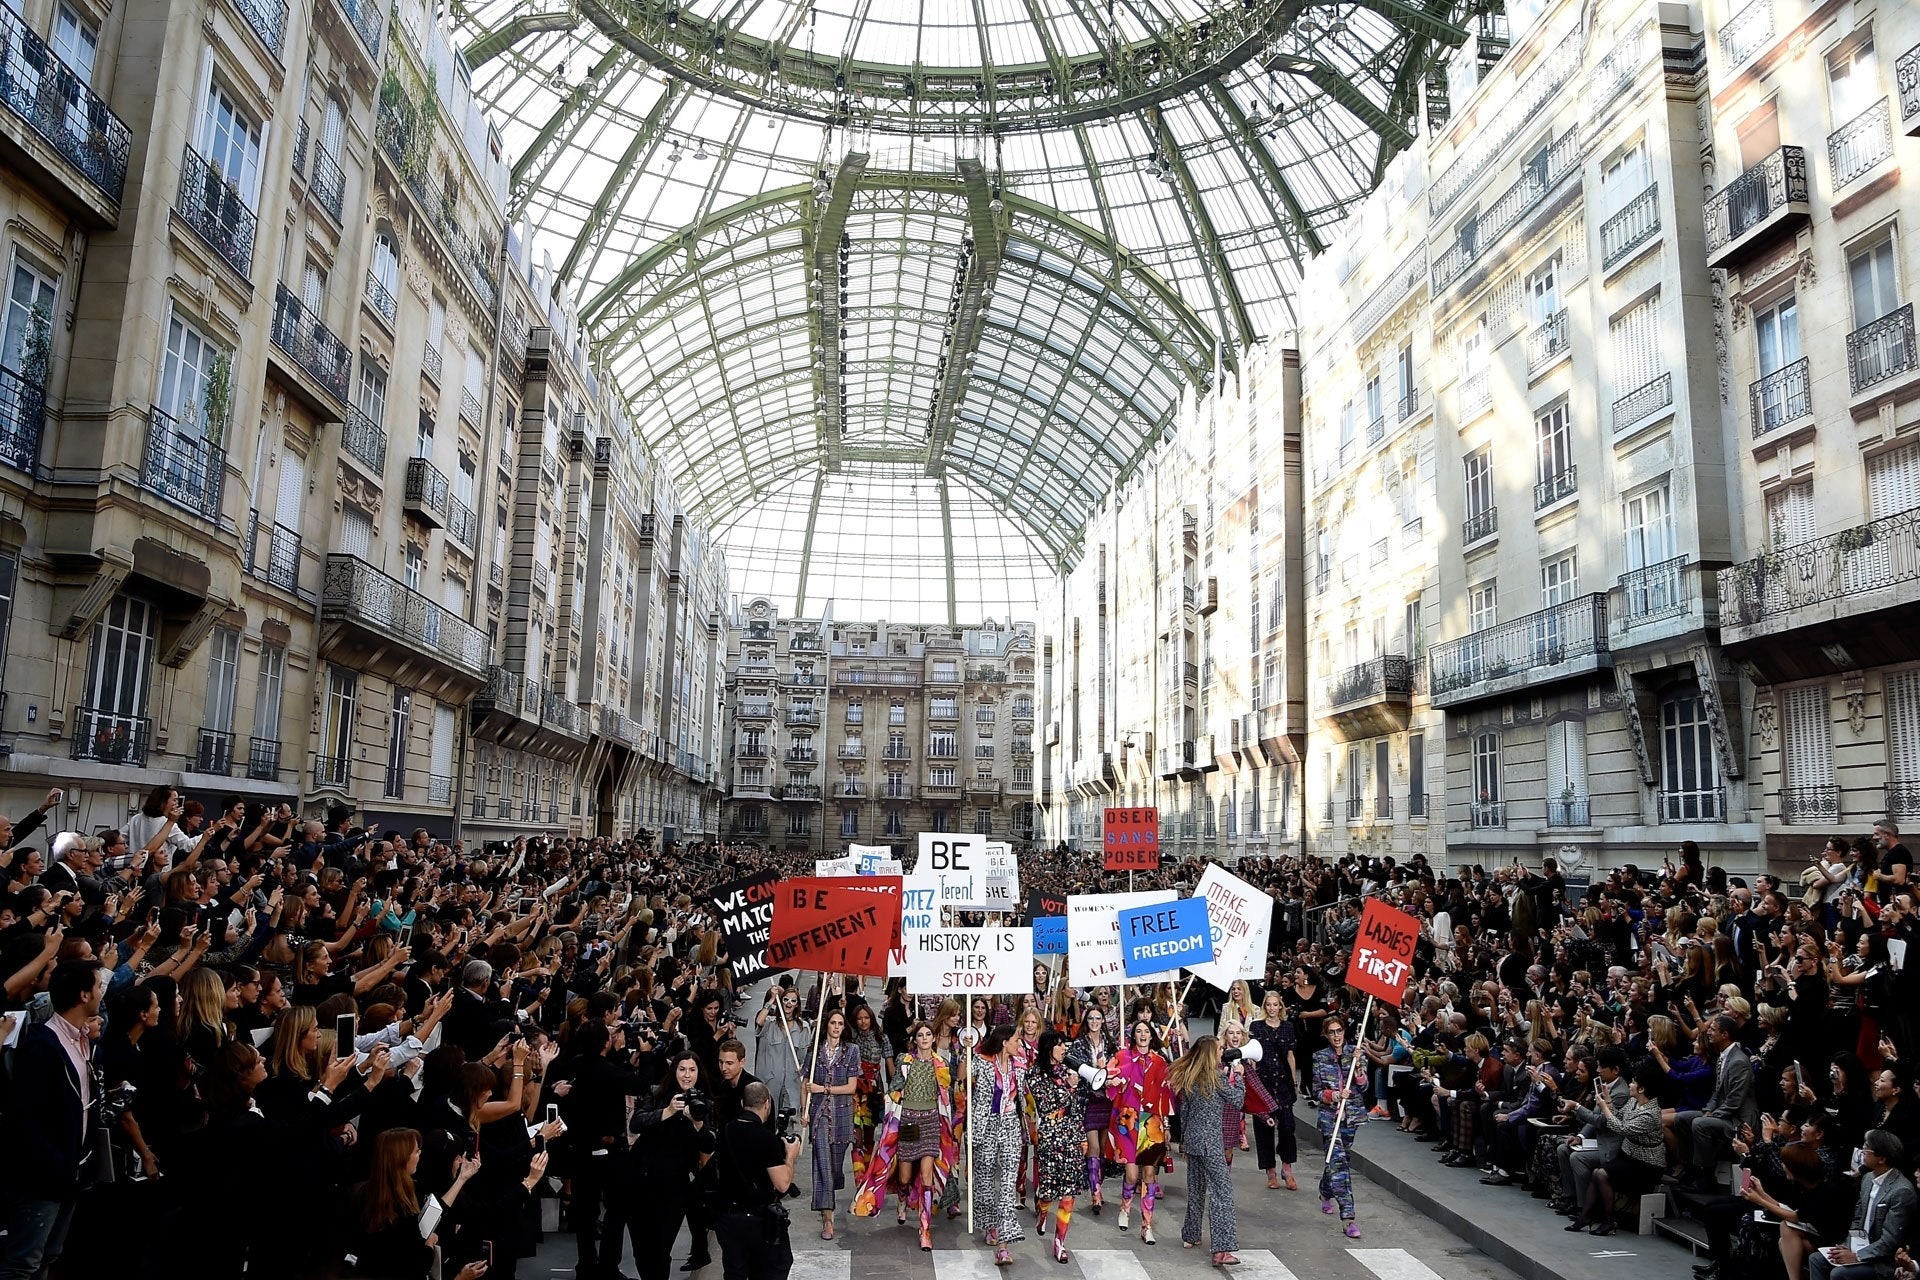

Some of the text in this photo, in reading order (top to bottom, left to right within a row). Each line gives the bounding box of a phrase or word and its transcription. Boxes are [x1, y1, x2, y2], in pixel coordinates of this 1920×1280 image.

[1106, 810, 1153, 824] OSER
[1106, 830, 1154, 844] SANS
[931, 841, 970, 870] BE
[1104, 850, 1158, 864] POSER
[714, 879, 776, 912] WE CAN
[793, 888, 829, 910] BE
[902, 889, 935, 911] OTEZ
[1206, 881, 1248, 916] MAKE
[1074, 903, 1115, 913] WOMEN'S
[1206, 899, 1250, 938] ASHION
[1130, 909, 1180, 938] FREE
[746, 927, 770, 945] THE
[769, 906, 877, 964] DIFFERENT
[919, 933, 1015, 952] HISTORY IS
[1074, 938, 1119, 948] ARE MORE
[1133, 934, 1204, 961] FREEDOM
[732, 948, 770, 978] MAC
[954, 954, 988, 970] HER
[941, 972, 996, 988] STORY
